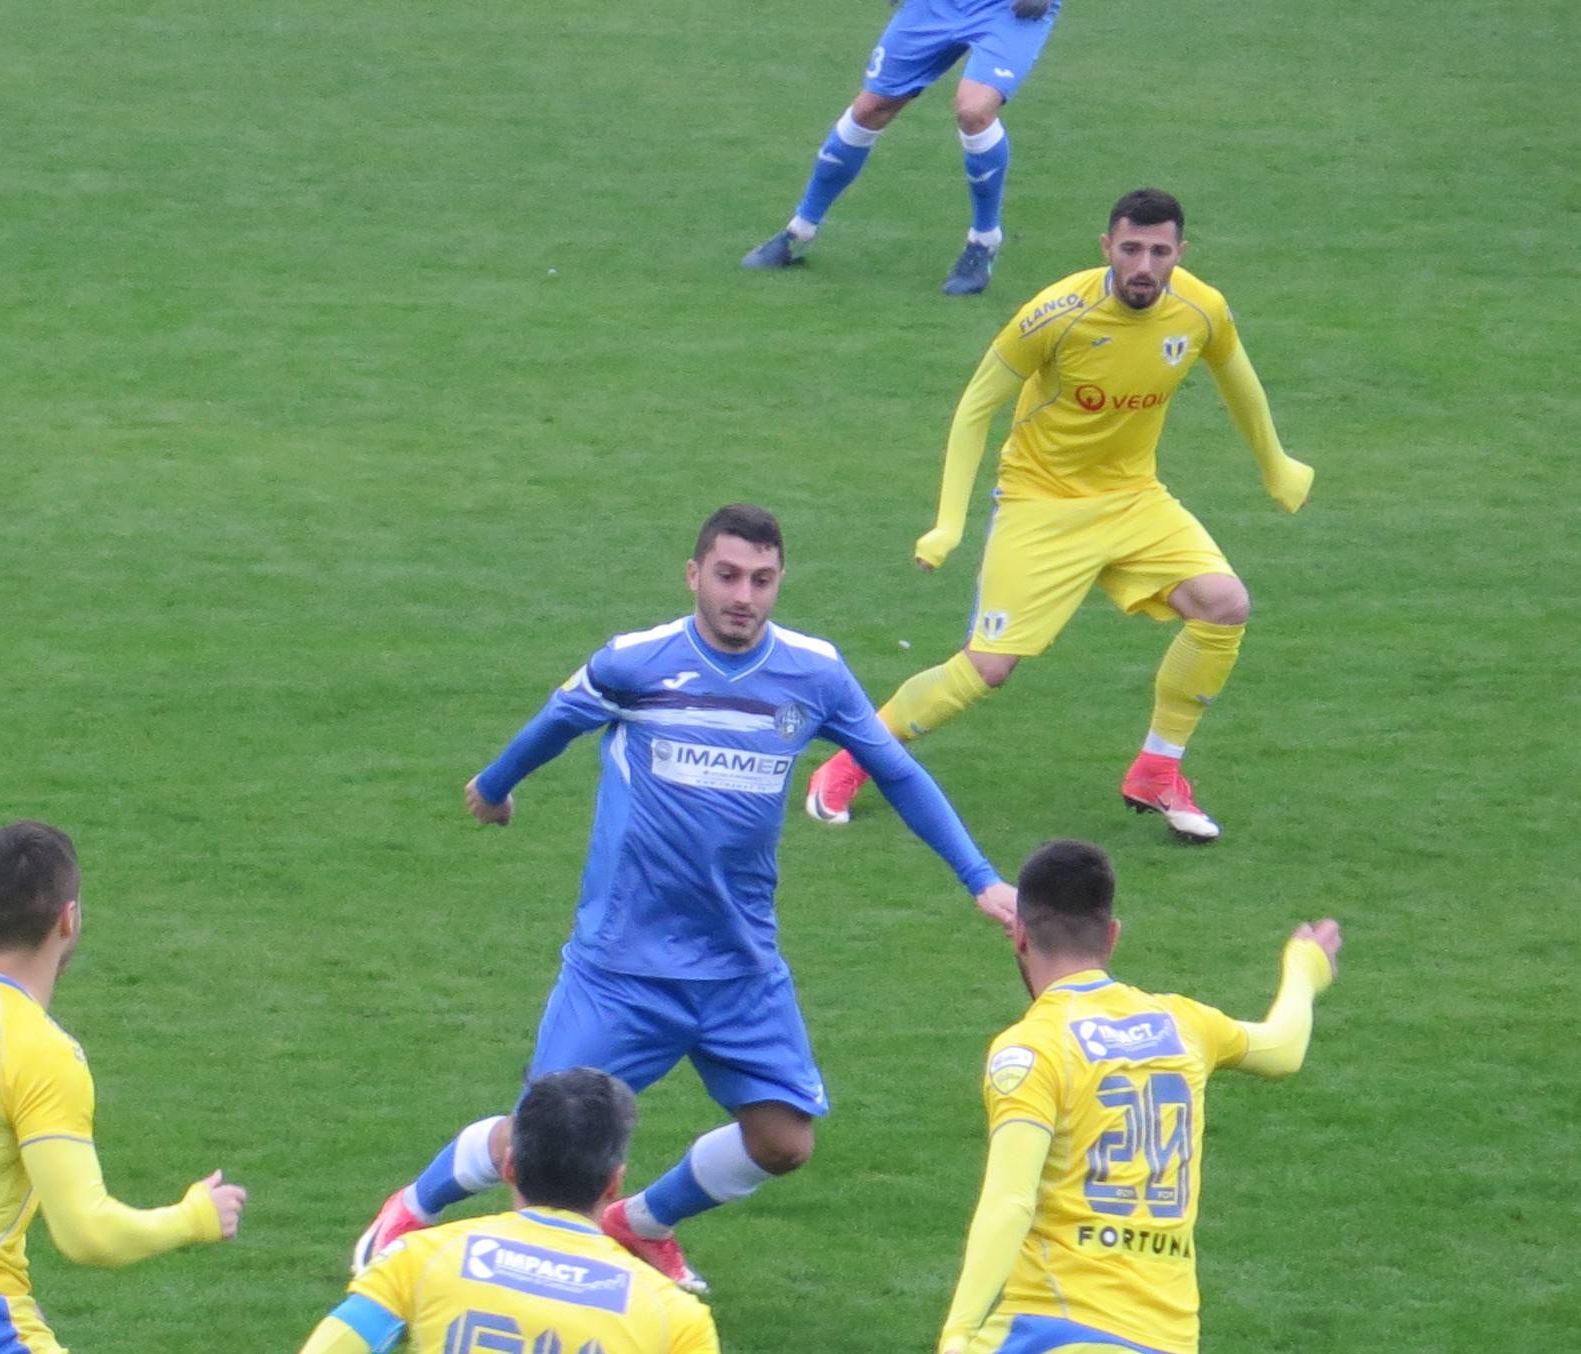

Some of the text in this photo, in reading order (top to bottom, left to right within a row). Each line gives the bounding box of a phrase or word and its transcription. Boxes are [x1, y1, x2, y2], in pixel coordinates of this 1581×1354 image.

[676, 747, 789, 776] IMAMED
[1085, 1073, 1192, 1218] 20
[494, 1248, 589, 1283] IMPACT
